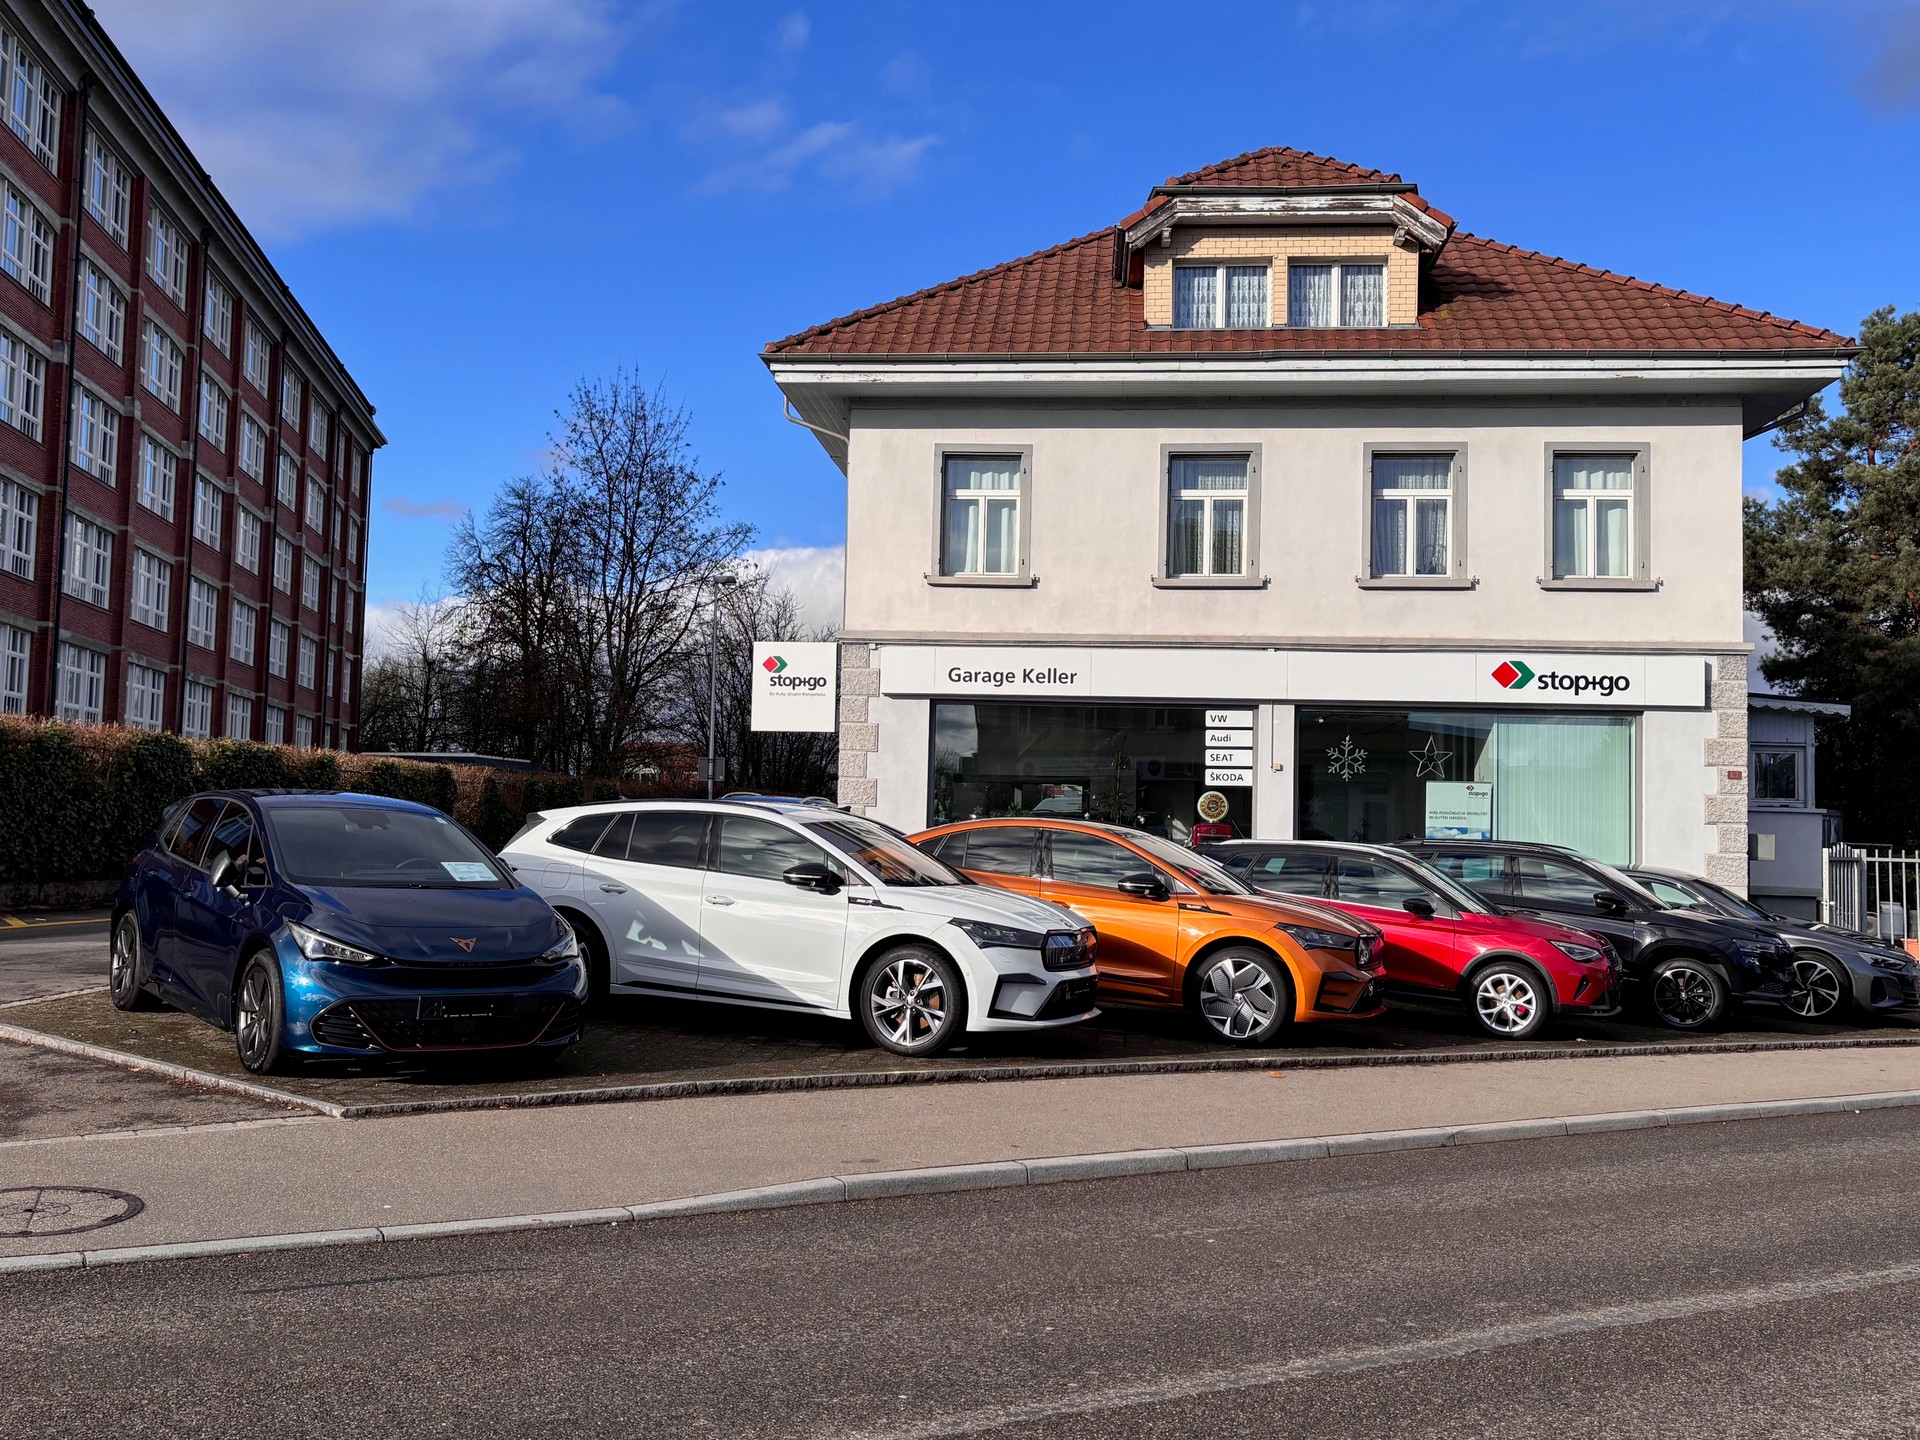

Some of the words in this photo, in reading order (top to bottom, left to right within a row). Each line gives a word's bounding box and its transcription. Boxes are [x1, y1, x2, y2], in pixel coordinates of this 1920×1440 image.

[770, 674, 827, 690] stop+go
[948, 667, 1016, 688] Garage
[1023, 668, 1078, 684] Keller
[1537, 671, 1631, 697] stop+go
[1210, 715, 1228, 723] VW
[1210, 734, 1232, 742] Audi
[1210, 753, 1234, 762] SEAT
[1210, 772, 1244, 781] ŠKODA
